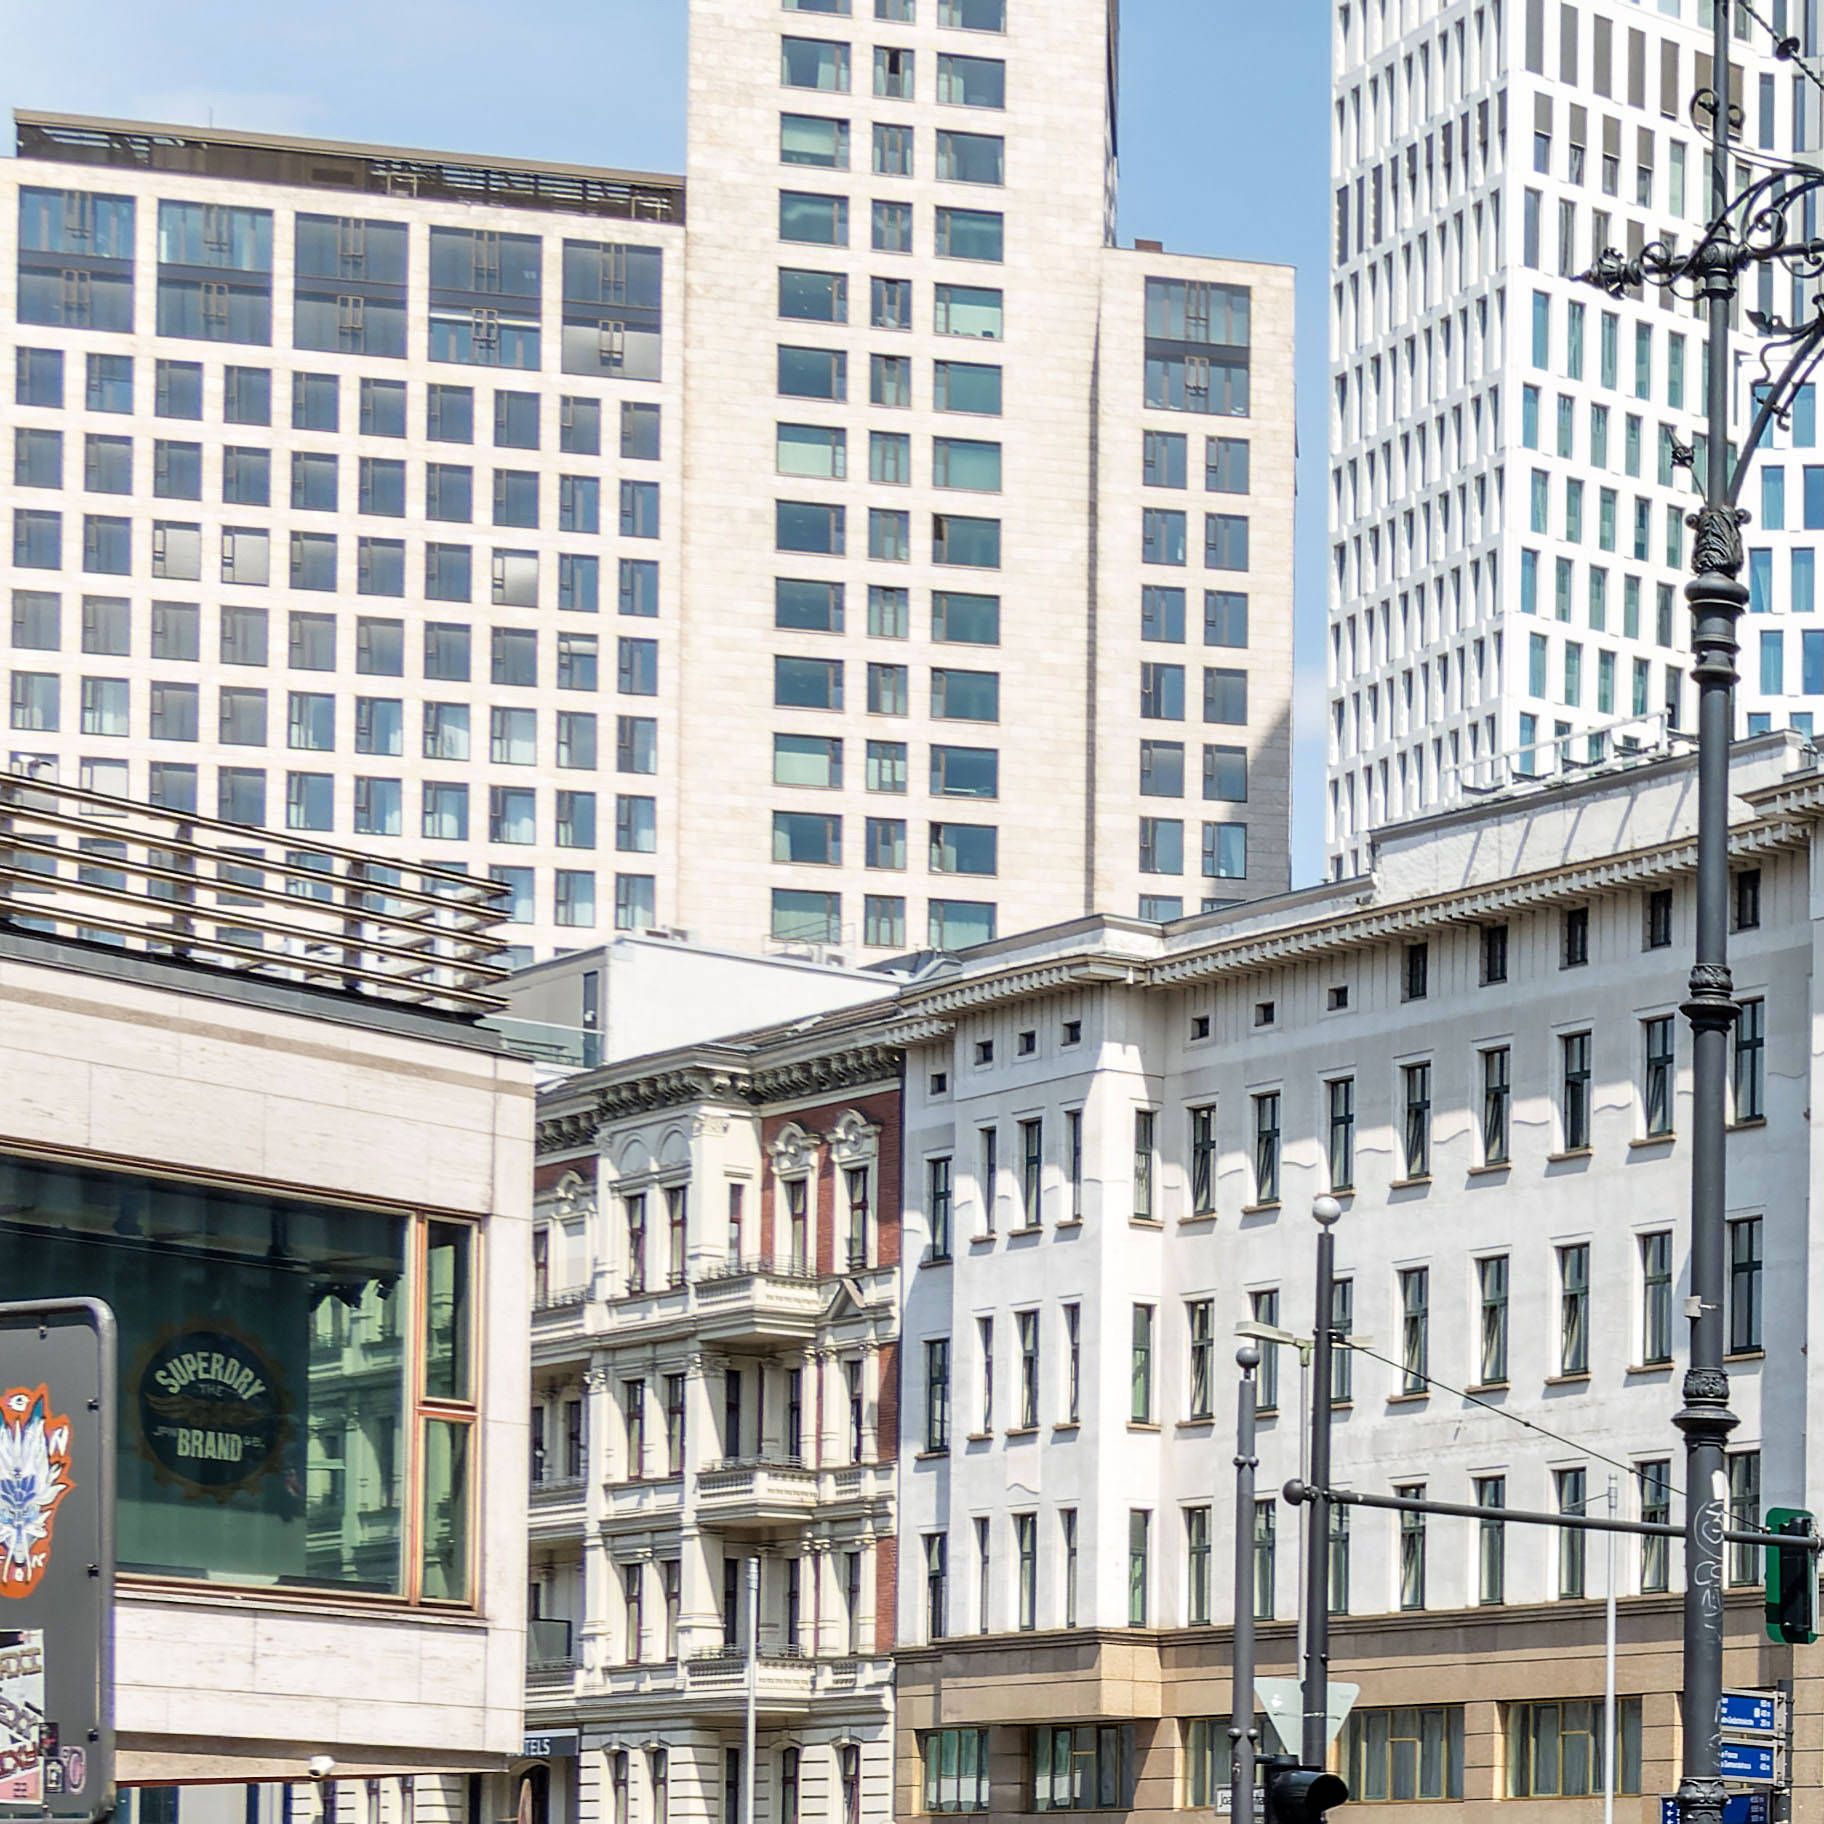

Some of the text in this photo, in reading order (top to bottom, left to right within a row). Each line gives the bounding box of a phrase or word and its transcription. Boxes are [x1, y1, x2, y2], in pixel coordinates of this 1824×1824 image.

[155, 1352, 266, 1400] SUPERDRY
[176, 1428, 243, 1462] BRAND
[524, 1738, 551, 1756] TELS
